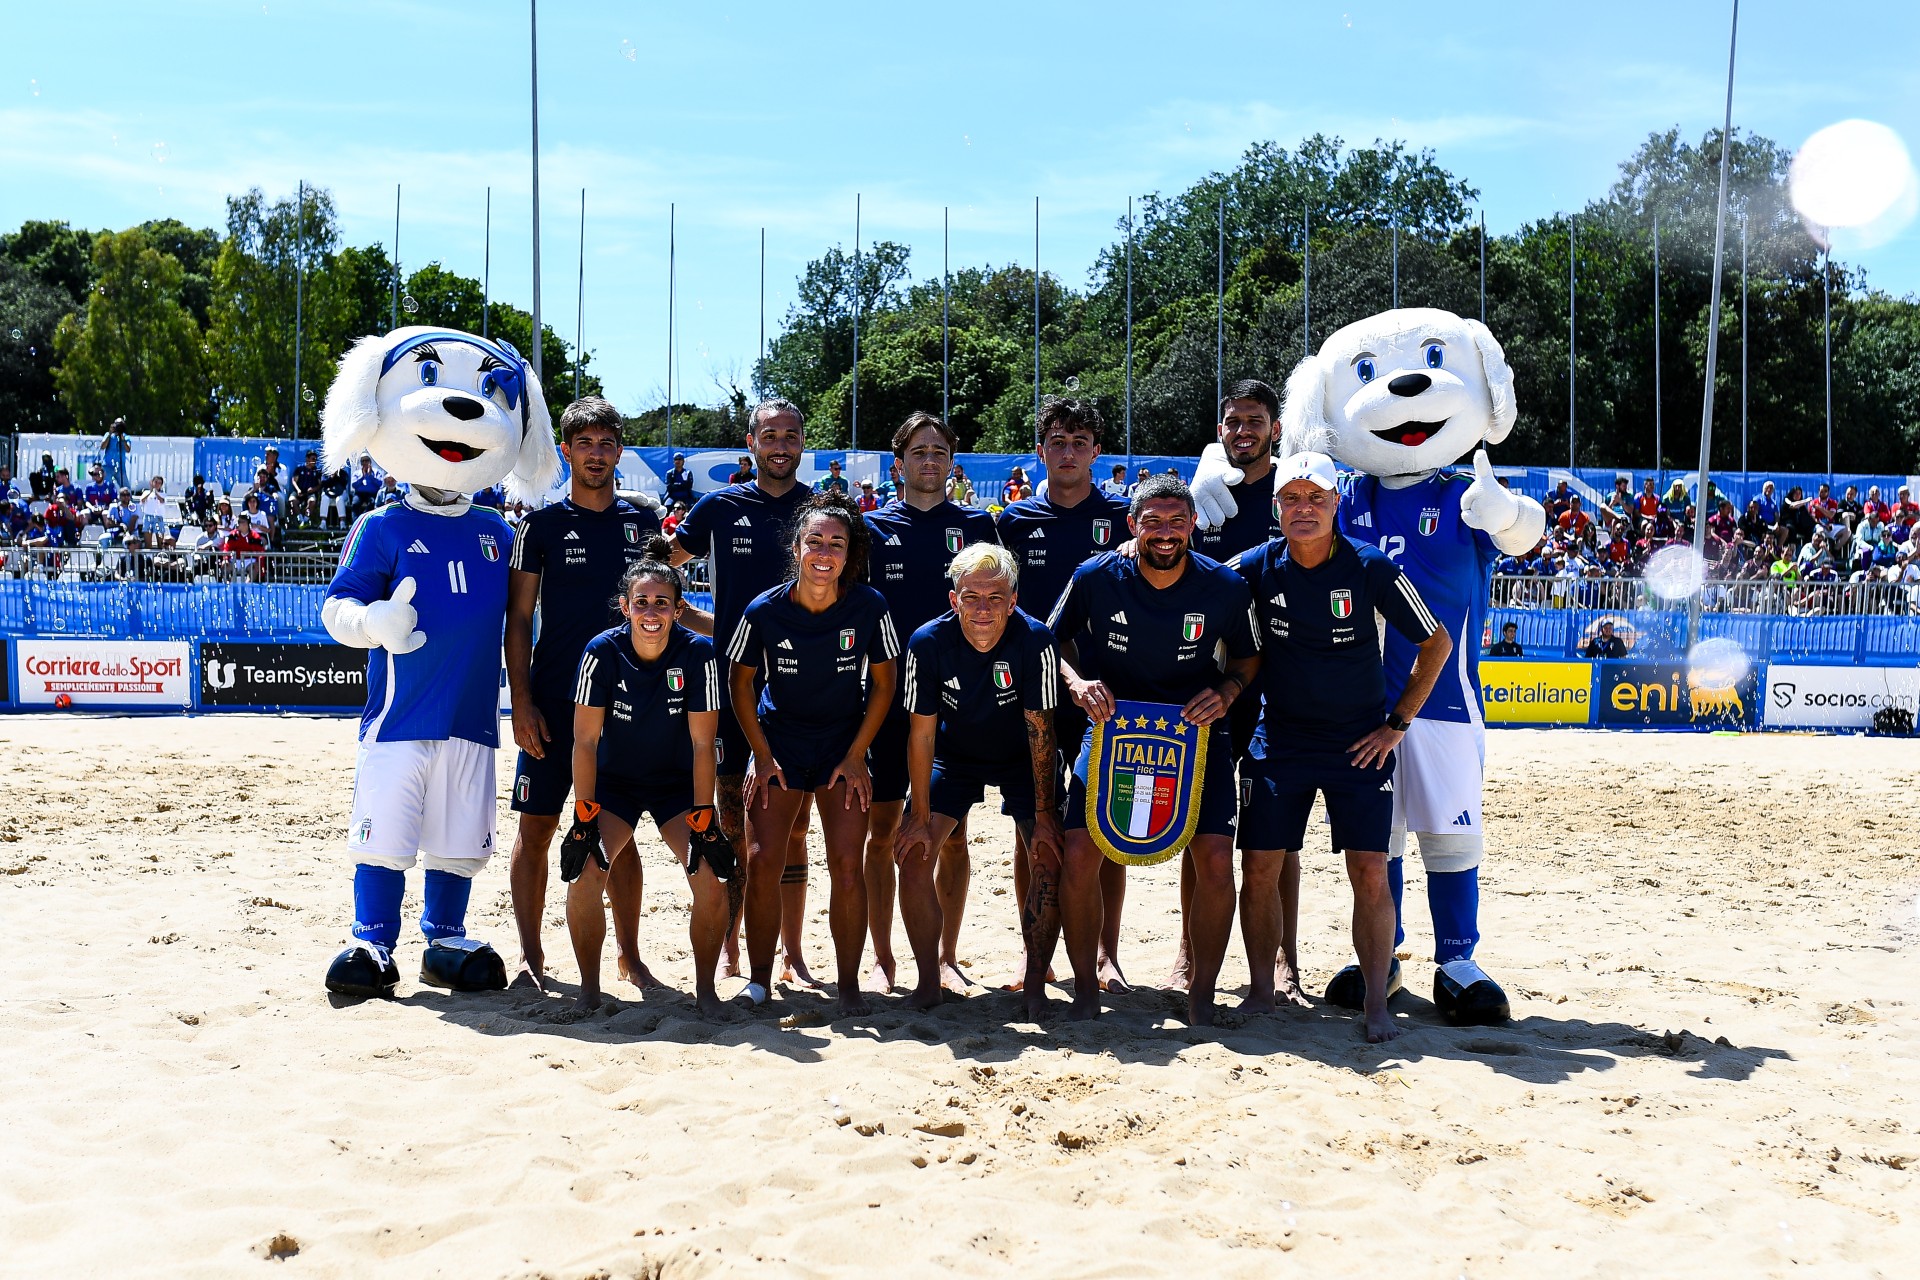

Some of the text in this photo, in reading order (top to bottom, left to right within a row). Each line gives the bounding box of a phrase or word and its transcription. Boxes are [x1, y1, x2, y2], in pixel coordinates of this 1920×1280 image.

[1379, 535, 1405, 570] 12
[447, 560, 468, 594] 11
[1332, 591, 1349, 599] ITALIA
[25, 655, 182, 683] Corriere dello Sport
[242, 665, 363, 688] TeamSystem
[50, 682, 157, 692] SEMPLICEMENTE PASSIONE
[1483, 682, 1588, 704] teitaliane
[1611, 671, 1680, 712] eni
[1804, 693, 1913, 708] socios.com
[1116, 742, 1177, 768] ITALIA
[1136, 765, 1155, 774] FIGC
[354, 922, 384, 936] ITALIA
[436, 924, 465, 933] ITALIA
